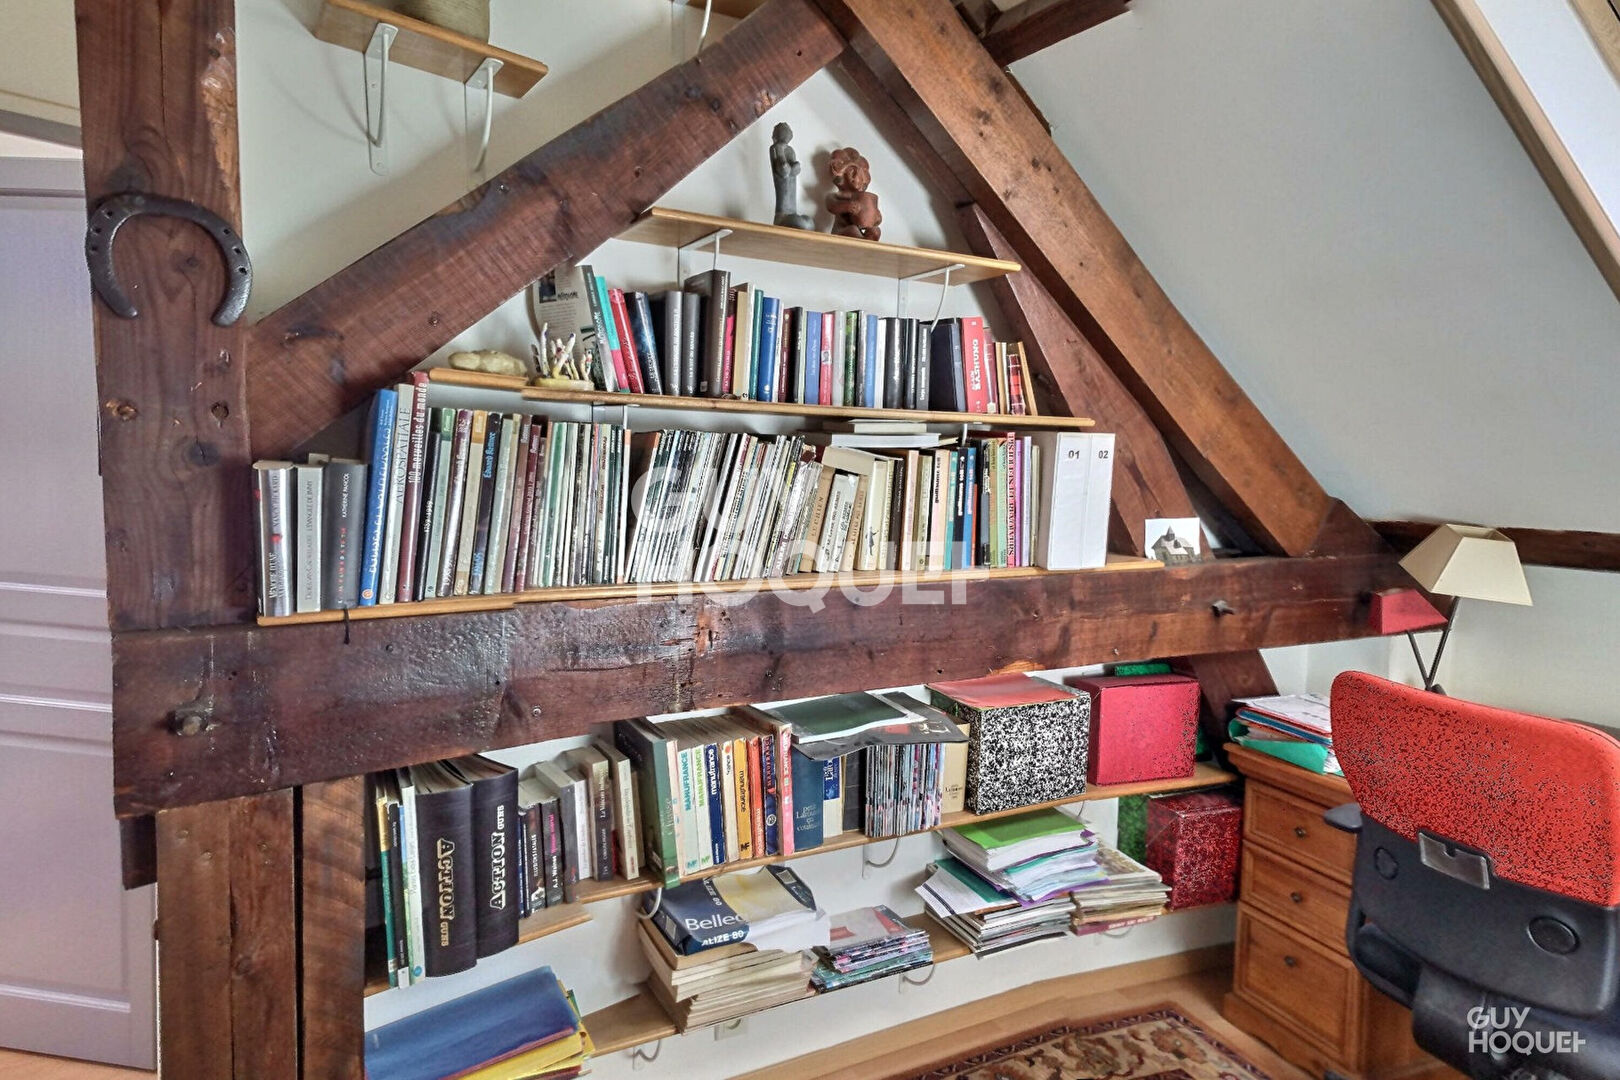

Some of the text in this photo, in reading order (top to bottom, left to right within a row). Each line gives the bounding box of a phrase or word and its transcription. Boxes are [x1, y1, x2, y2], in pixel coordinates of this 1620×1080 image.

[408, 382, 427, 483] 100 merveilles du monde
[1068, 450, 1080, 459] 01
[1098, 450, 1109, 459] 02
[681, 752, 691, 811] MANUFRANCE
[695, 749, 705, 807] MANUFRANCE
[708, 749, 717, 795] manufrance
[437, 838, 455, 947] ACTION GUNS
[489, 832, 505, 909] ACTION
[701, 930, 744, 946] ALIZE 80
